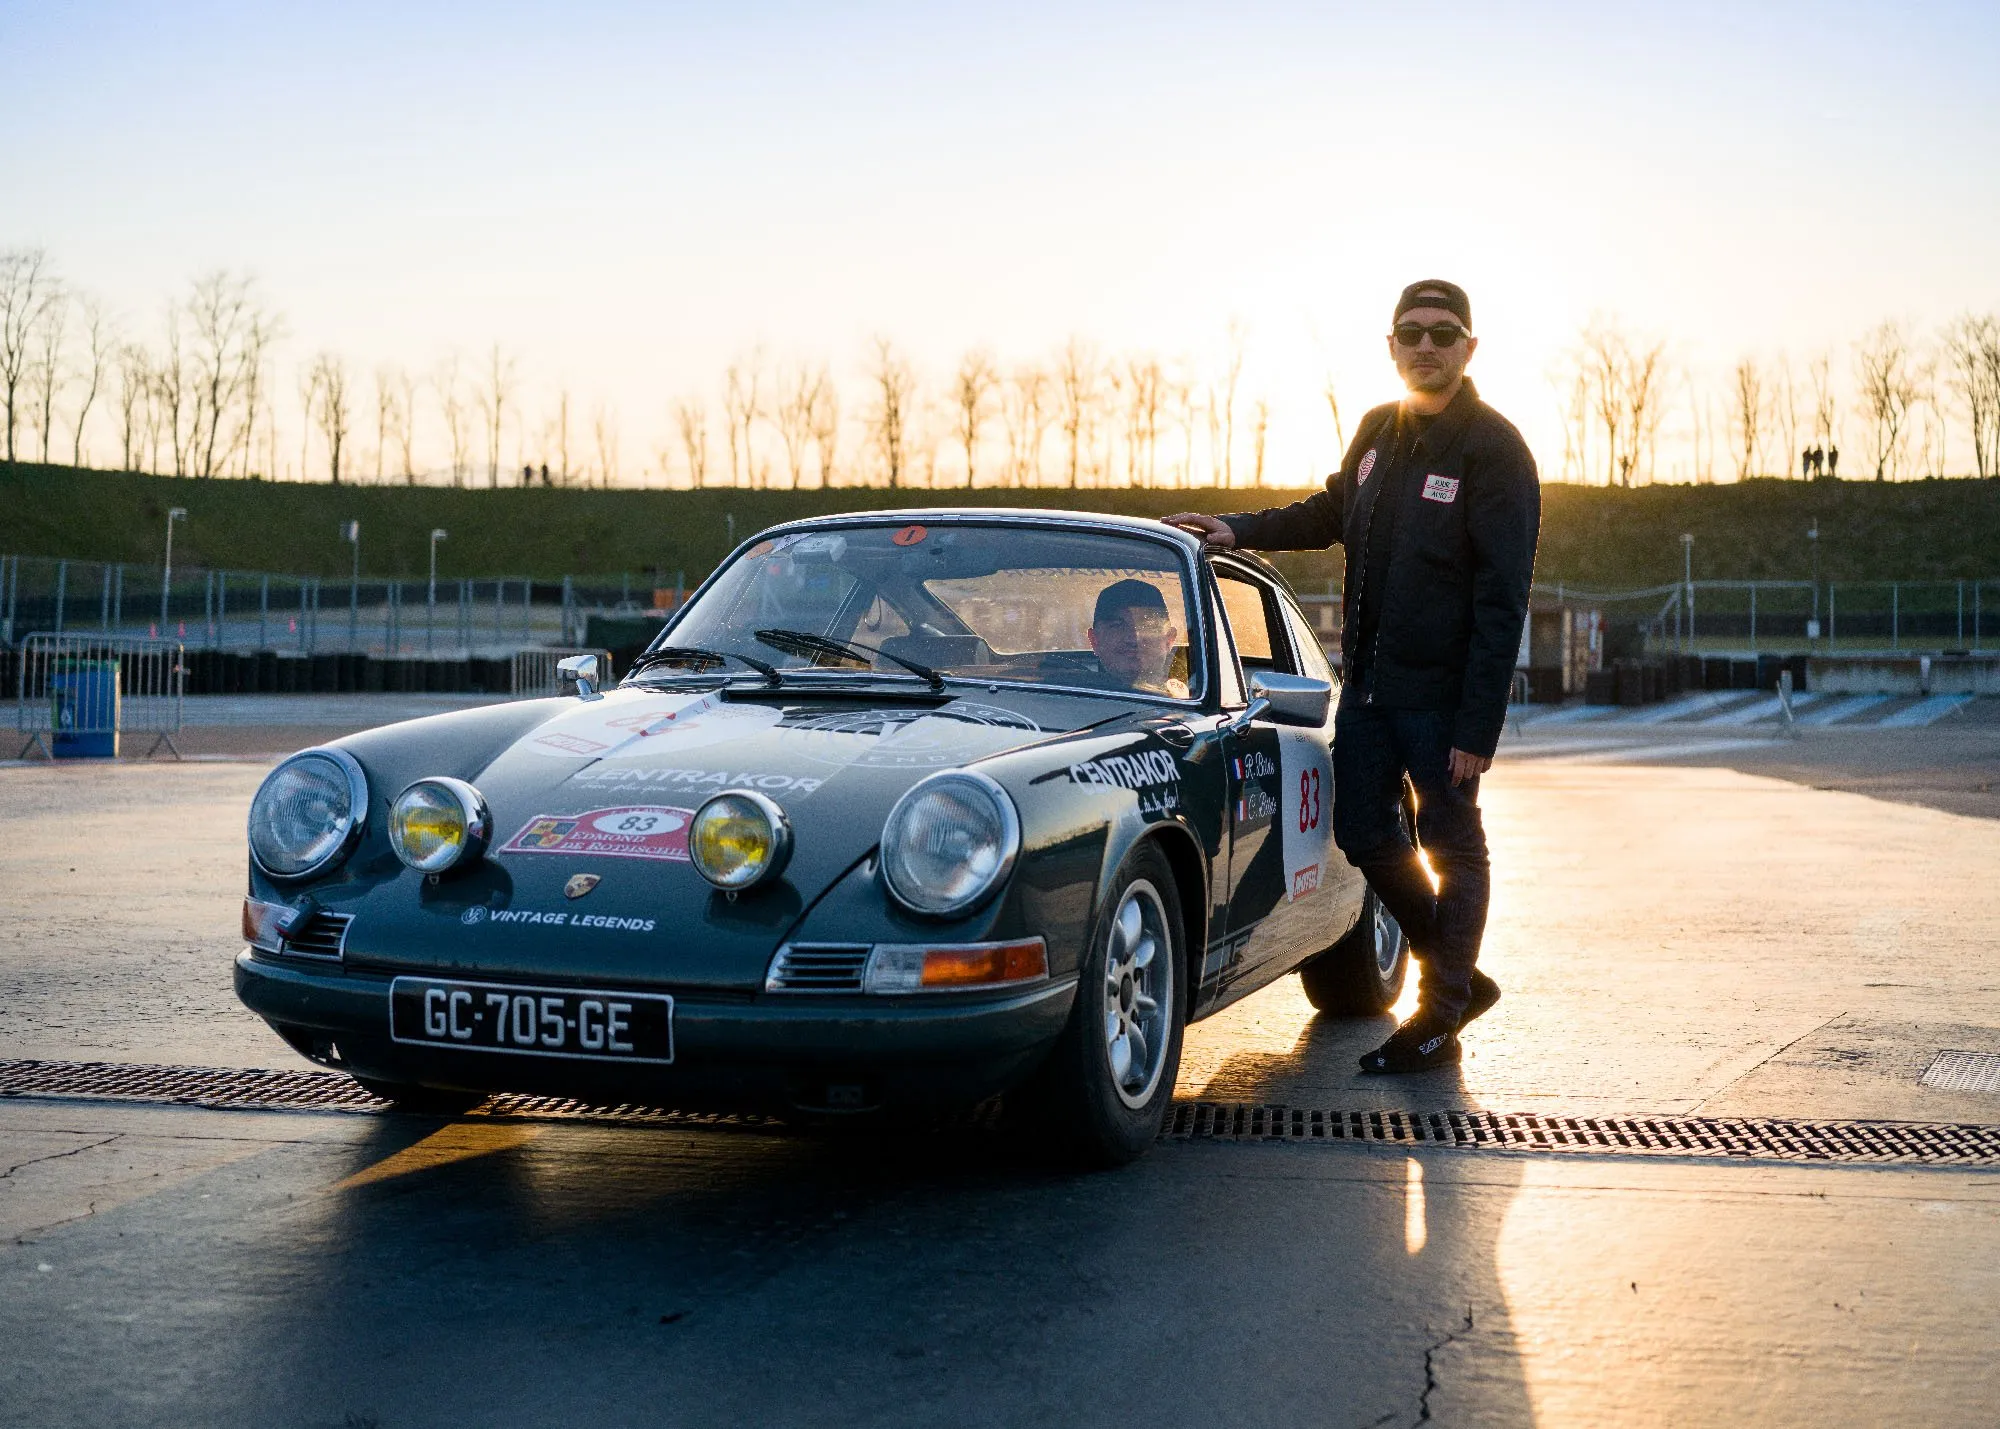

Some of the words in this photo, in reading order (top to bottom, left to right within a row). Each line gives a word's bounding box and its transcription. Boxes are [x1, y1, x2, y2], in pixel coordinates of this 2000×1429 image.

[573, 767, 822, 793] CENTRAKOR
[1069, 750, 1182, 795] CENTRAKOR
[1300, 767, 1320, 833] 83
[618, 811, 659, 832] 83
[570, 831, 647, 843] EDMOND
[560, 842, 586, 850] DE
[588, 842, 687, 857] ROTHSCHIL
[490, 910, 567, 926] VINTAGE
[570, 914, 656, 932] LEGENDS
